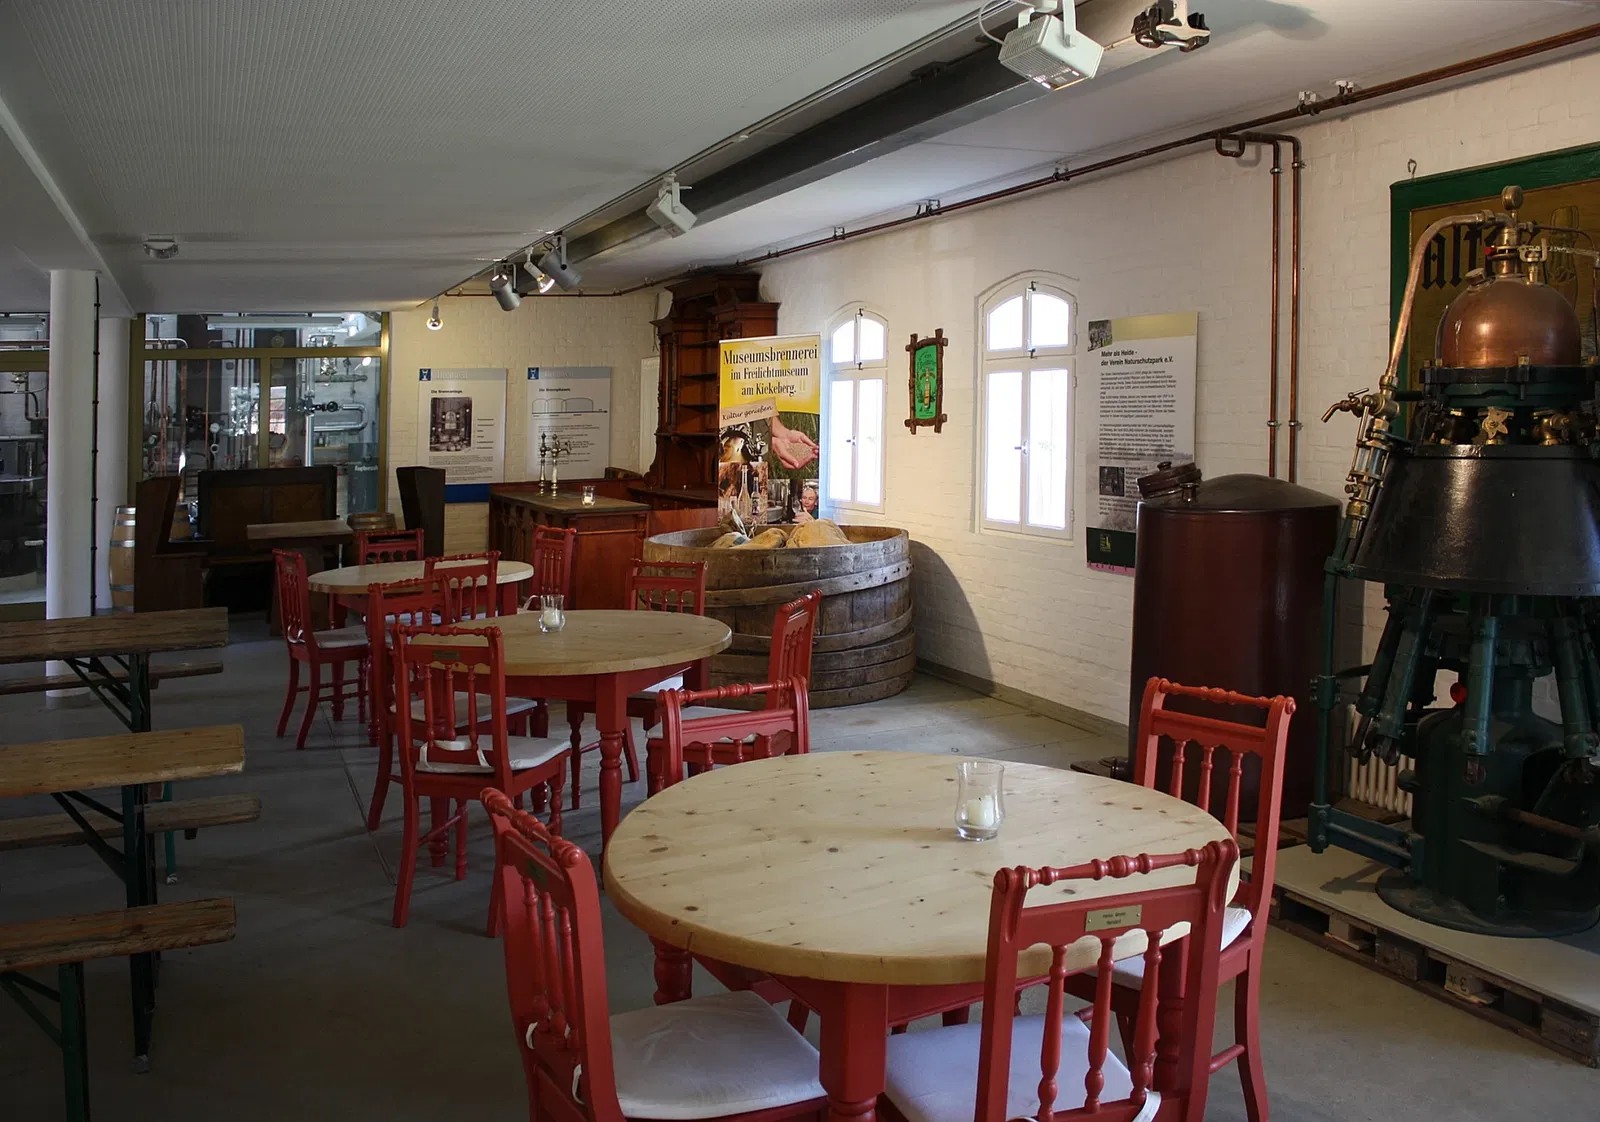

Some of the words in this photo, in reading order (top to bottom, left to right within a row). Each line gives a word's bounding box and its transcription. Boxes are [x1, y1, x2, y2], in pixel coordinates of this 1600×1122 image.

[723, 344, 818, 365] Museumsbrennerei
[1109, 358, 1124, 366] Verein
[1124, 356, 1163, 365] Naturschutzpark
[730, 368, 742, 380] im
[743, 366, 808, 380] Freilichtmuseum
[741, 386, 754, 396] am
[756, 381, 797, 398] Kiekeberg.
[722, 410, 743, 421] Kultur
[744, 405, 773, 418] genießen
